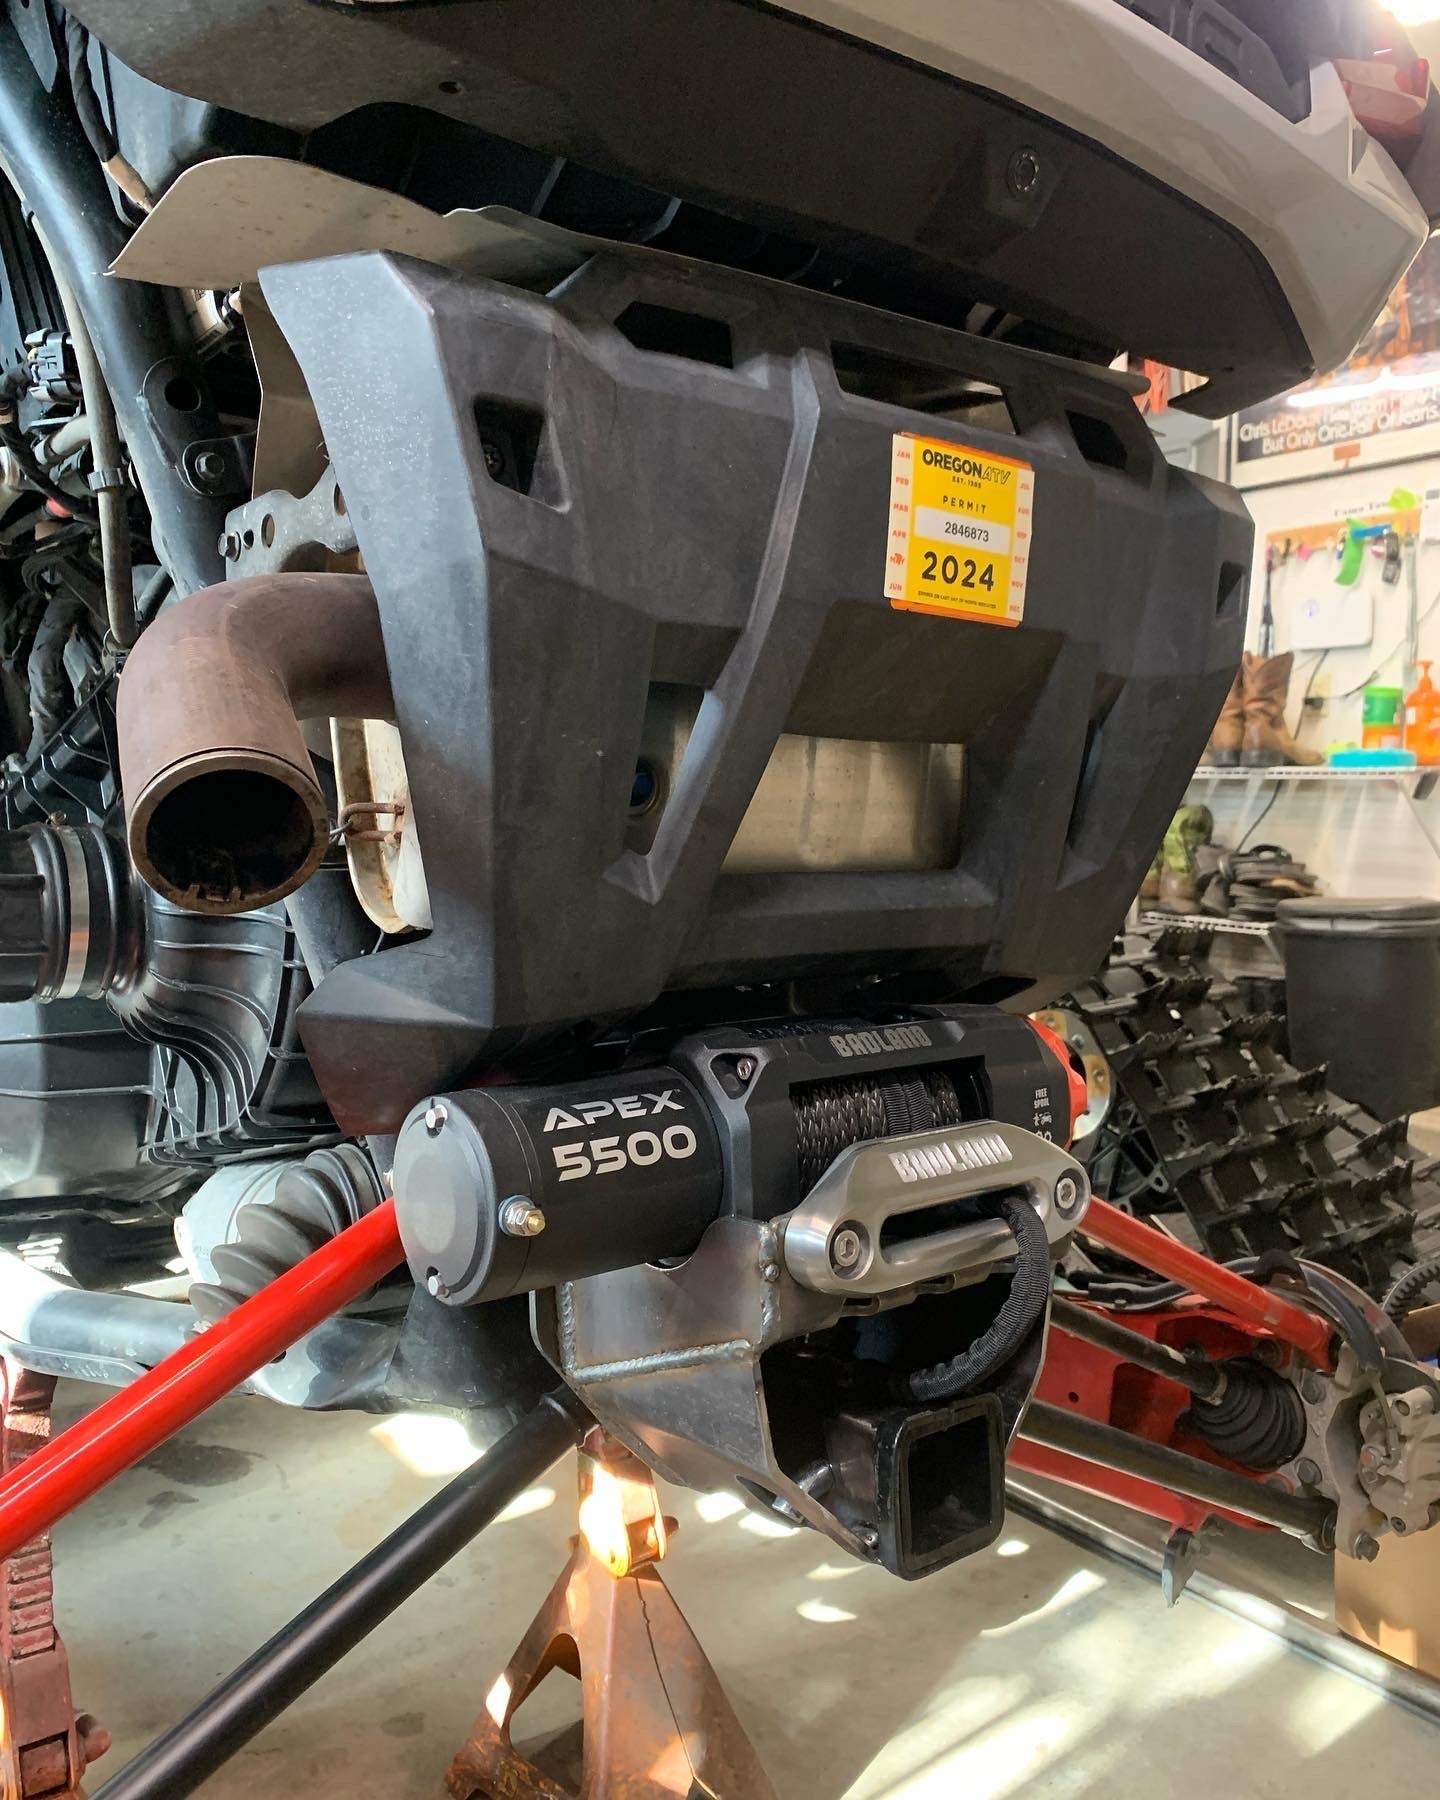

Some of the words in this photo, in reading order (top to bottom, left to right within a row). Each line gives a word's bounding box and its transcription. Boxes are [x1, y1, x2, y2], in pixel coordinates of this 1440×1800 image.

[1240, 422, 1270, 442] Chris
[1262, 435, 1285, 455] But
[1286, 429, 1317, 451] Only
[1318, 423, 1348, 443] One
[896, 450, 911, 460] JAN
[893, 503, 909, 513] MAR
[943, 495, 987, 513] PERMIT
[892, 530, 906, 539] APR
[944, 521, 989, 543] 2846873
[921, 551, 995, 591] 2024
[889, 583, 902, 591] JUN
[829, 1025, 932, 1058] BADLAND
[1035, 1087, 1048, 1098] FREE
[543, 1090, 685, 1132] APEX
[1033, 1097, 1050, 1110] SPOOL
[552, 1125, 697, 1182] 5500
[887, 1133, 1013, 1183] BADLAND
